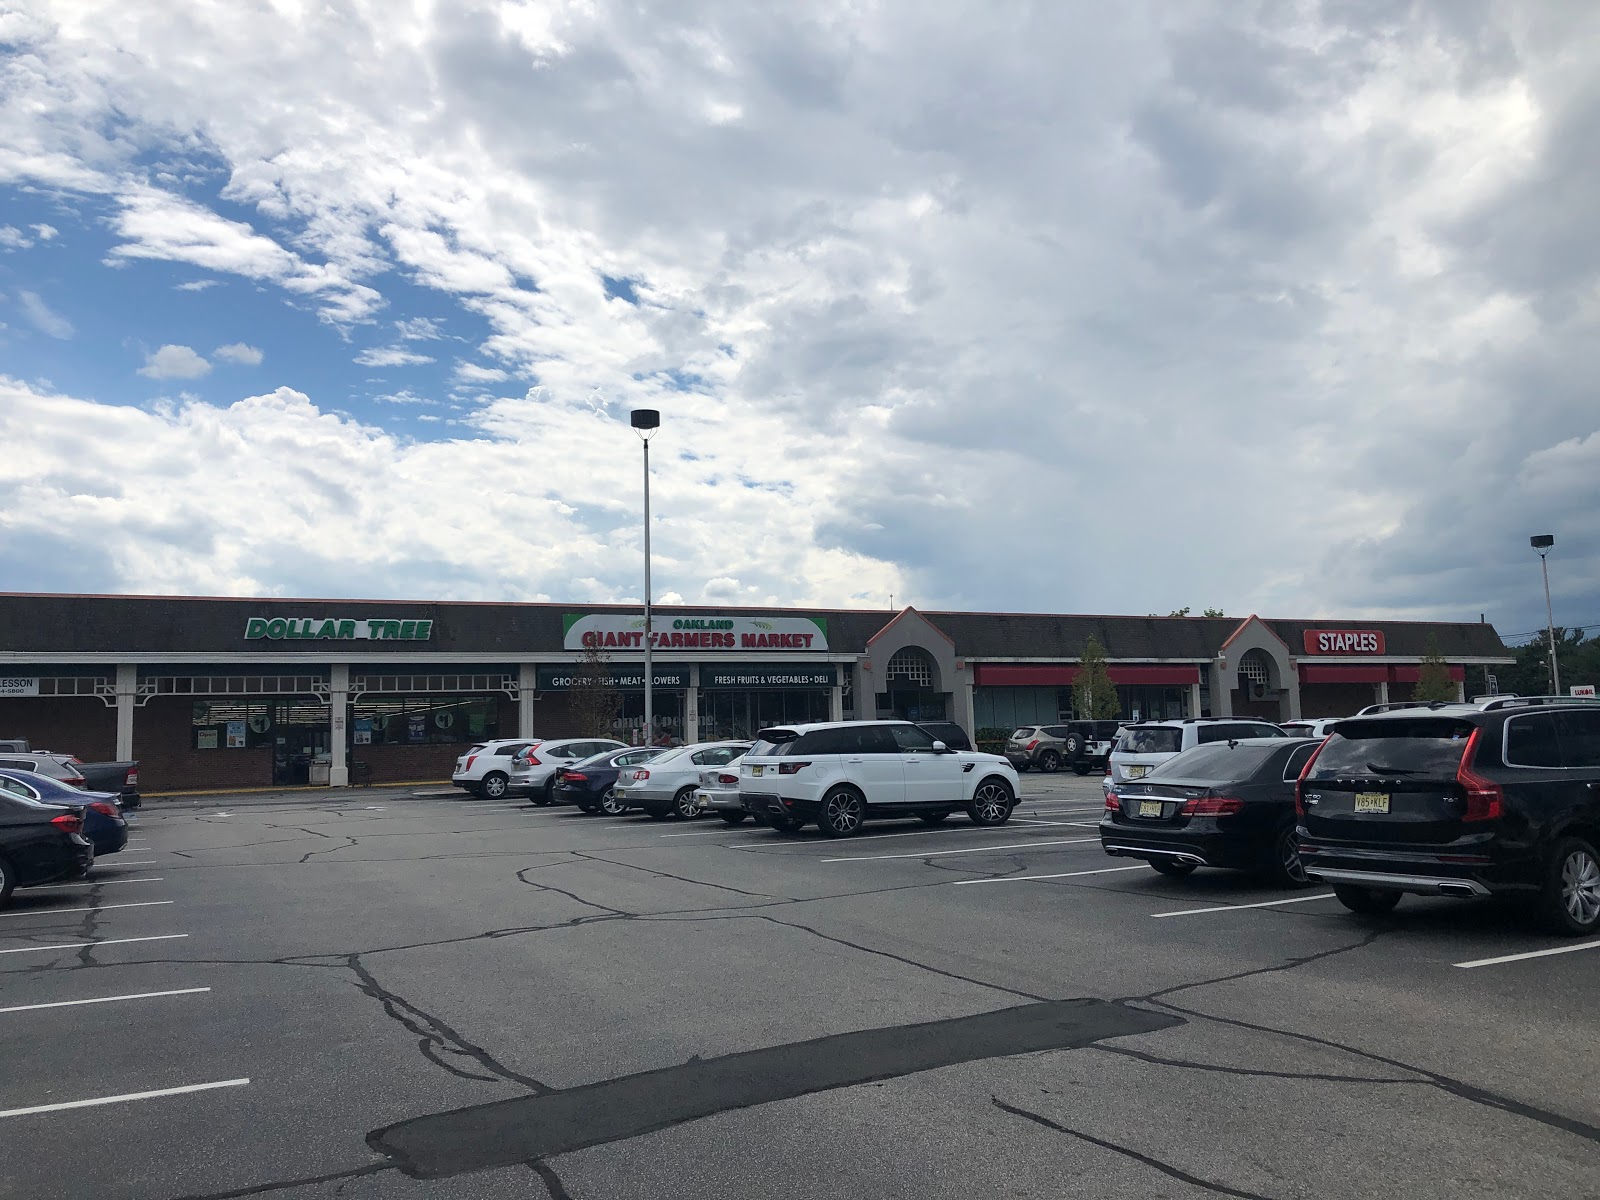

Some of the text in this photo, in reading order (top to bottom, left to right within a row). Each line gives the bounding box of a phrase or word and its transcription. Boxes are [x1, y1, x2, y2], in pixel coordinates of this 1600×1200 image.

[246, 619, 432, 639] DOLLAR TREE
[673, 619, 734, 630] OAKLAND
[582, 631, 643, 647] GIANT
[741, 633, 814, 648] MARKET
[1319, 633, 1378, 651] STAPLES
[0, 679, 33, 687] ESSON
[620, 676, 642, 685] MEAT
[651, 676, 680, 685] LOWERS
[714, 675, 828, 684] FRESH FRUITS & VEGETABLES DELI
